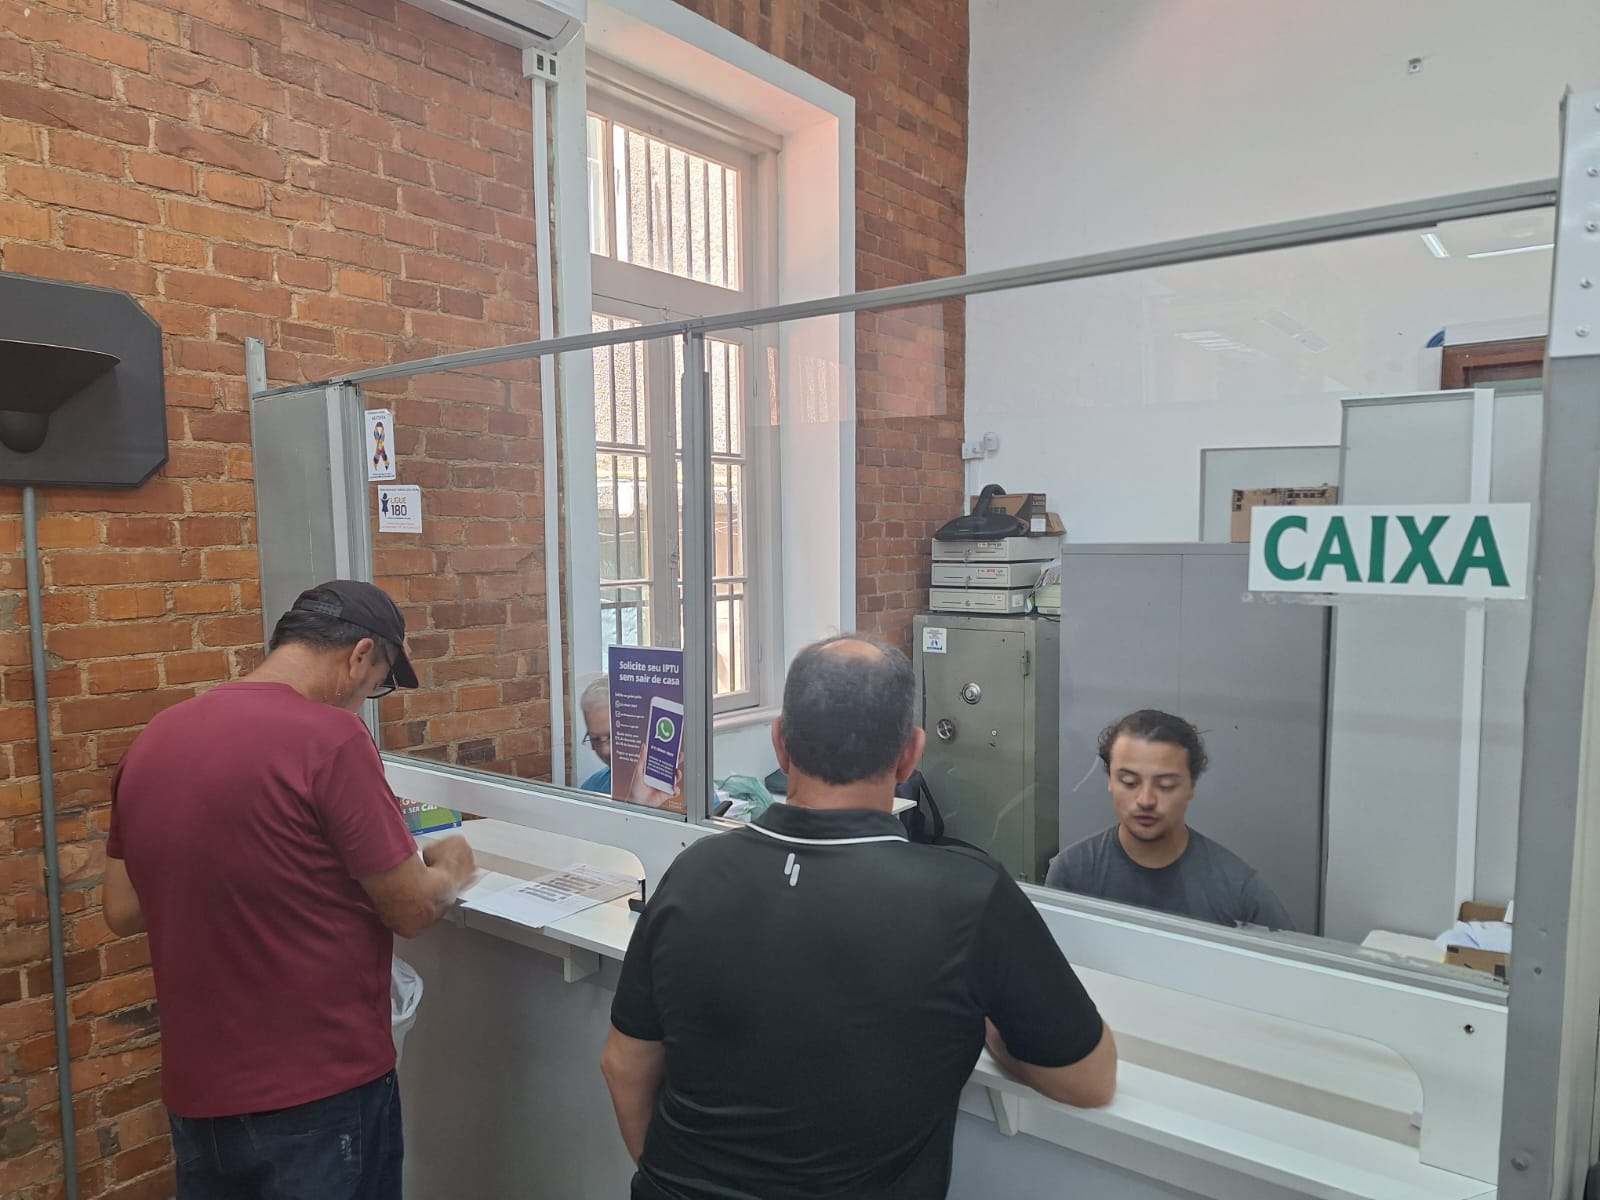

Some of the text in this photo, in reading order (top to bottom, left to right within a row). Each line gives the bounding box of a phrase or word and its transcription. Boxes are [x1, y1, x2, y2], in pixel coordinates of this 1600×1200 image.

[391, 504, 407, 517] 180
[1264, 515, 1511, 587] CAIXA
[619, 660, 680, 674] Solicite seu IPTU
[619, 673, 680, 686] sem sair de casa
